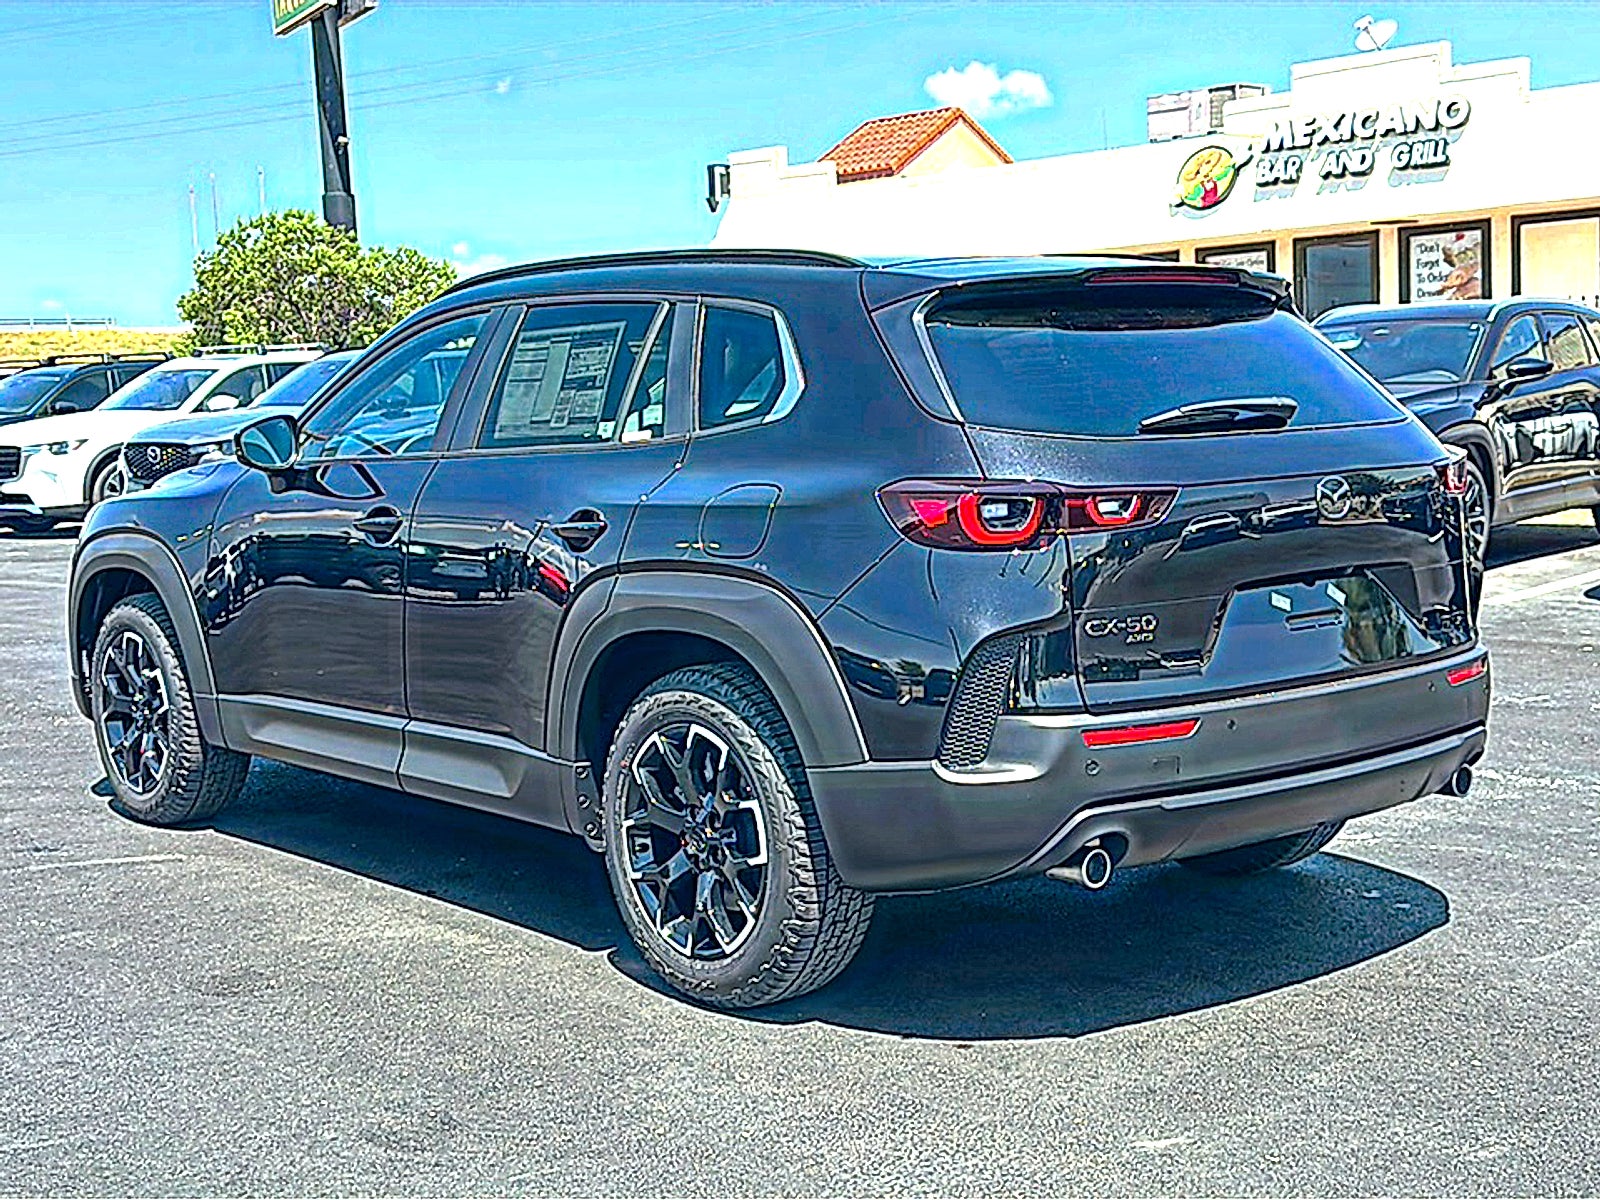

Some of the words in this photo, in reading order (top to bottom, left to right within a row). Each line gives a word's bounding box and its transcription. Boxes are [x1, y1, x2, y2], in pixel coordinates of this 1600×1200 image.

[1261, 94, 1470, 153] MEXICANO
[1256, 155, 1303, 187] BAR
[1319, 149, 1375, 180] AND
[1391, 138, 1450, 171] GRILL
[1416, 273, 1426, 284] To
[1084, 613, 1158, 638] CX-50
